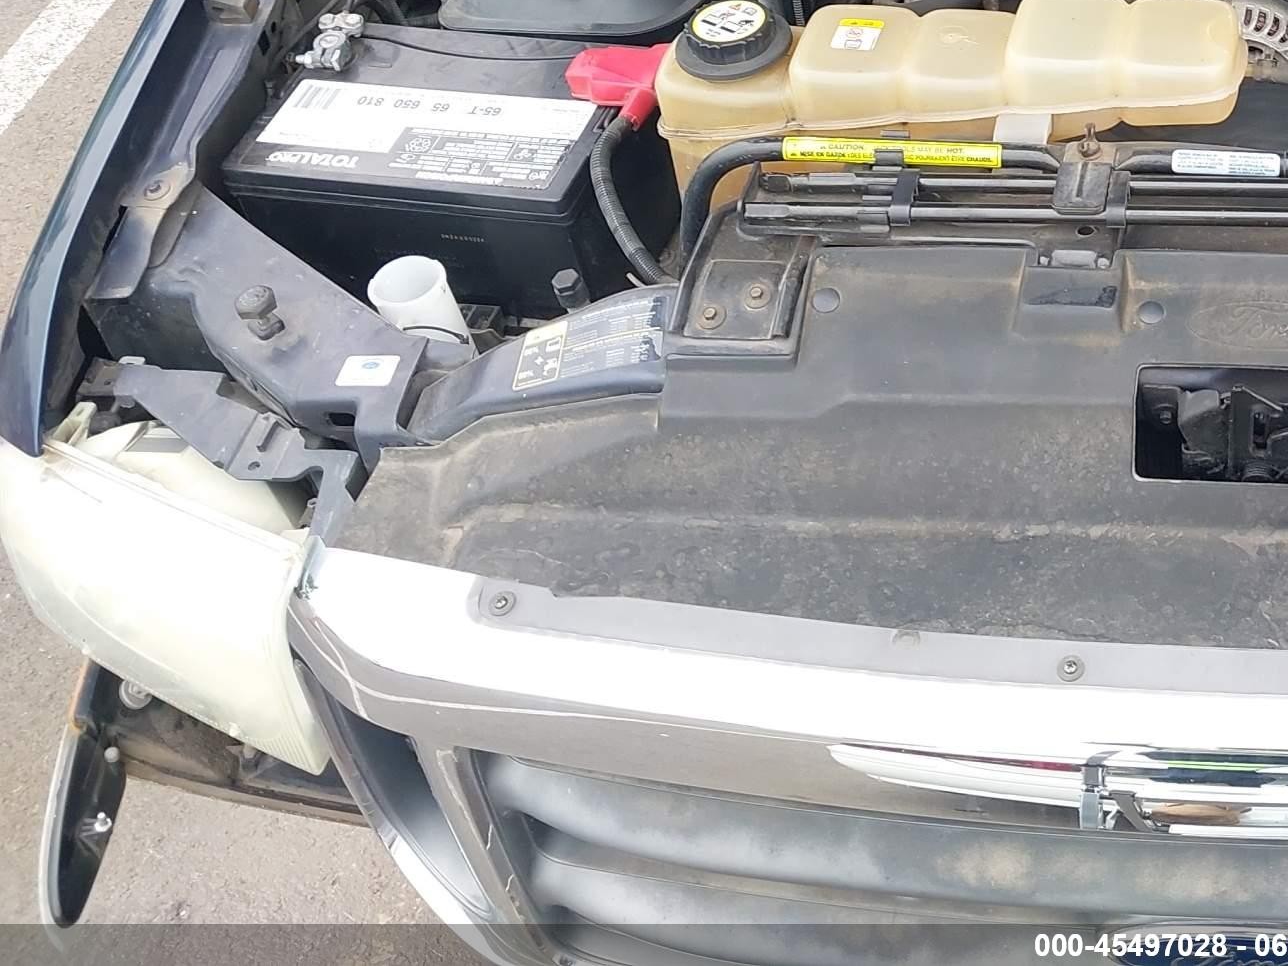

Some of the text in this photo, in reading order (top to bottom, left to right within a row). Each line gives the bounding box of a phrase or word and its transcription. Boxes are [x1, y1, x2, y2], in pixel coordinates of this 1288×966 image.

[358, 95, 502, 117] 65-T 65 650 810
[267, 150, 359, 168] TOTALPRO
